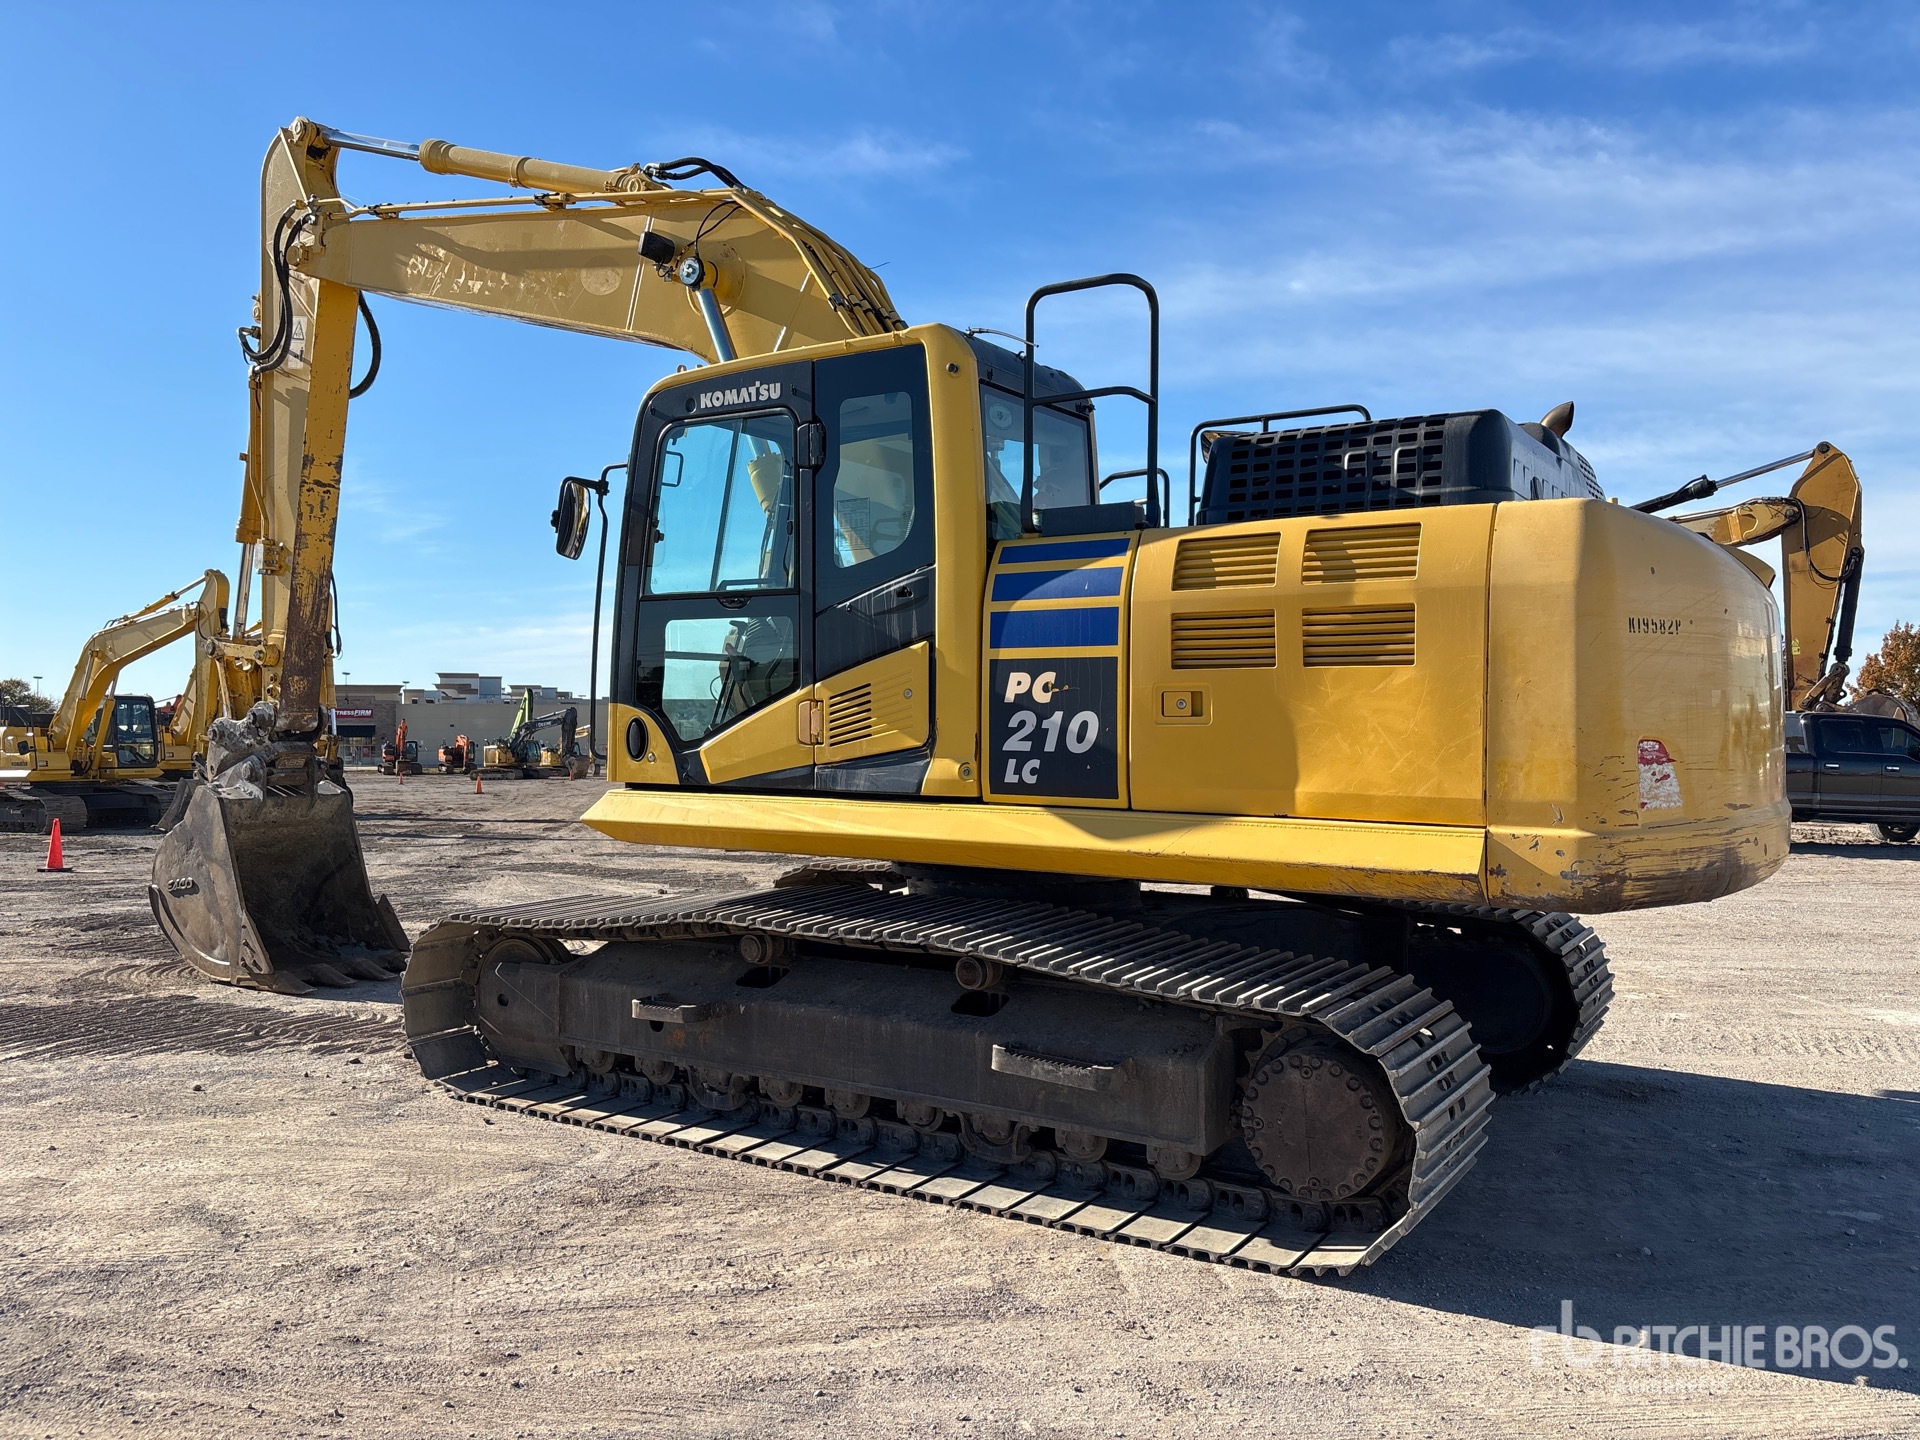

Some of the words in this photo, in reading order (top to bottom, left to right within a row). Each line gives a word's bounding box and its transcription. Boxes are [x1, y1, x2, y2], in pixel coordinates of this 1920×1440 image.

[700, 381, 781, 409] KOMATSU
[1004, 671, 1057, 704] PC
[1002, 710, 1099, 754] 210
[1004, 759, 1041, 784] LC
